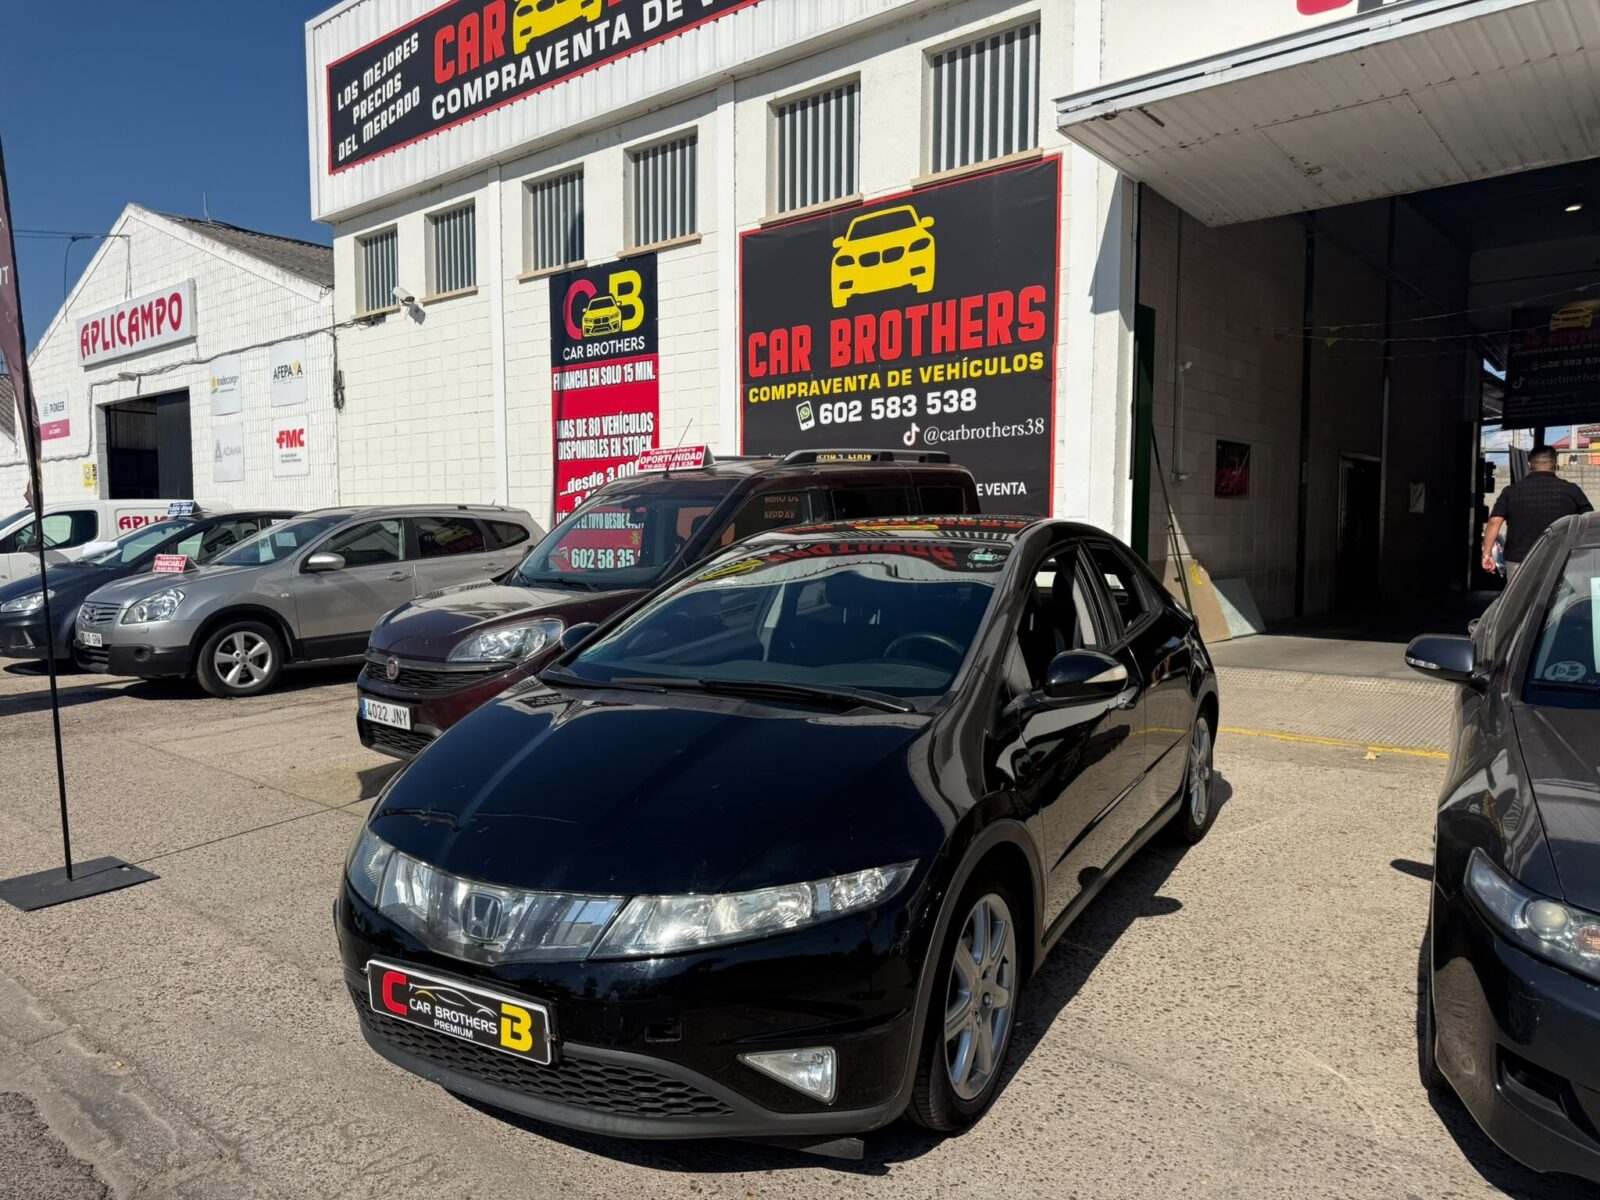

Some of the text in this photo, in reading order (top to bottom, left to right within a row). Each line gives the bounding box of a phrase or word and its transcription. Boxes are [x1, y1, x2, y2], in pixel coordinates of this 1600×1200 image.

[431, 0, 684, 120] COMPRAVENTA DE
[434, 0, 506, 84] CAR
[338, 32, 418, 111] LOS MEJORES
[353, 72, 401, 125] PRECIOS
[338, 86, 420, 162] DEL MERCADO
[609, 270, 644, 331] B
[80, 291, 183, 361] APLICAMPO
[748, 284, 1046, 378] CAR BROTHERS
[563, 336, 646, 361] CAR BROTHERS
[553, 360, 656, 391] FINANCIA EN SOLO 15 MIN.
[749, 351, 1044, 404] COMPRAVENTA DE VEHÍCULOS
[557, 411, 654, 439] MAS DE 80 VEHÍCULOS
[819, 388, 977, 425] 602 583 538
[276, 428, 304, 449] FMC
[558, 435, 652, 461] DISPONIBLES EN STOCK
[923, 418, 1045, 445] @carbrothers38
[640, 451, 703, 465] OPORTUNIDAD
[985, 482, 1027, 496] VENTA
[588, 513, 604, 529] TUYO
[605, 513, 626, 529] DESDE
[571, 547, 635, 569] 602 58 35
[368, 700, 407, 727] 4022 JNY
[382, 971, 407, 1016] C
[409, 998, 497, 1035] CAR BROTHERS
[433, 1019, 473, 1039] PREMIUM
[501, 1003, 533, 1052] B
